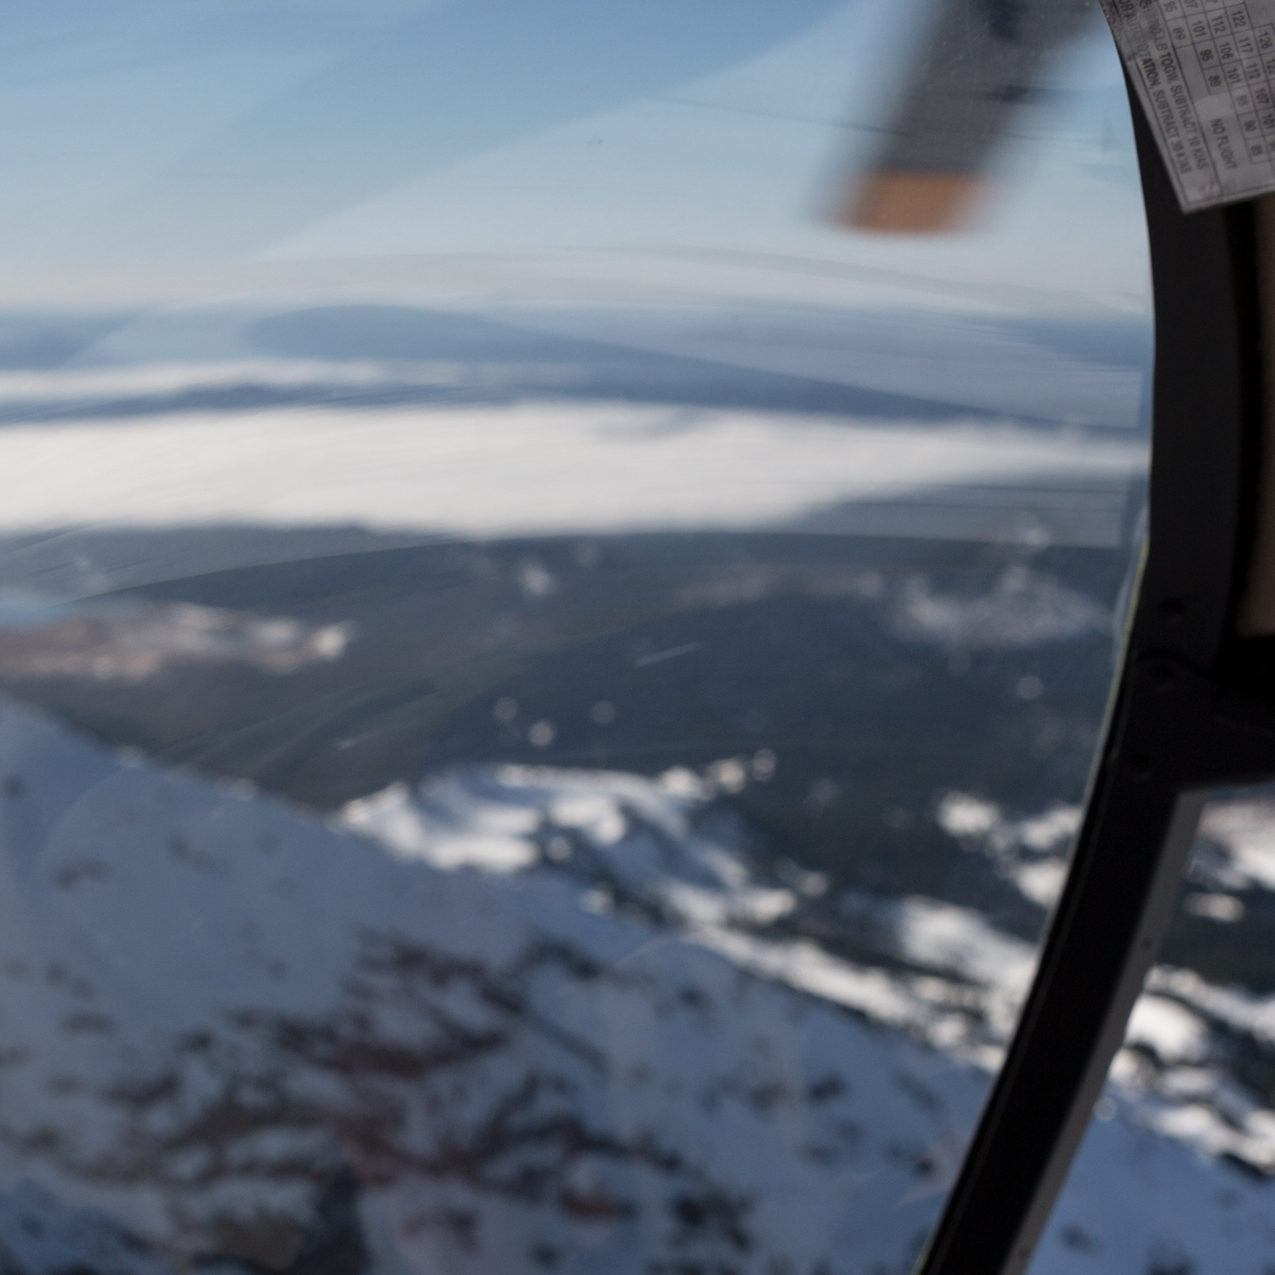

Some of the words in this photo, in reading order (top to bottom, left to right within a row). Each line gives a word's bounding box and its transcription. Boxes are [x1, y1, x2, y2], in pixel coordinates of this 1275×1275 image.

[1163, 0, 1177, 12] 95
[1210, 15, 1226, 33] 112
[1230, 10, 1246, 28] 122
[1172, 26, 1186, 41] 89
[1191, 20, 1206, 37] 101
[1153, 35, 1168, 51] LB
[1237, 36, 1253, 55] 117
[1257, 31, 1273, 50] 126
[1199, 48, 1214, 62] 95
[1218, 42, 1234, 59] 106
[1226, 67, 1241, 84] 101
[1245, 62, 1260, 80] 112
[1207, 74, 1222, 88] 89
[1235, 94, 1249, 107] 95
[1253, 87, 1269, 106] 107
[1169, 83, 1198, 135] SUBTRACT
[1152, 88, 1180, 139] SUBTRACT
[1170, 139, 1184, 152] 30
[1209, 117, 1226, 135] NO
[1243, 119, 1257, 133] 90
[1261, 113, 1275, 129] 101
[1188, 135, 1201, 147] 10
[1191, 146, 1209, 169] KIAS
[1215, 134, 1237, 170] FLIGHT
